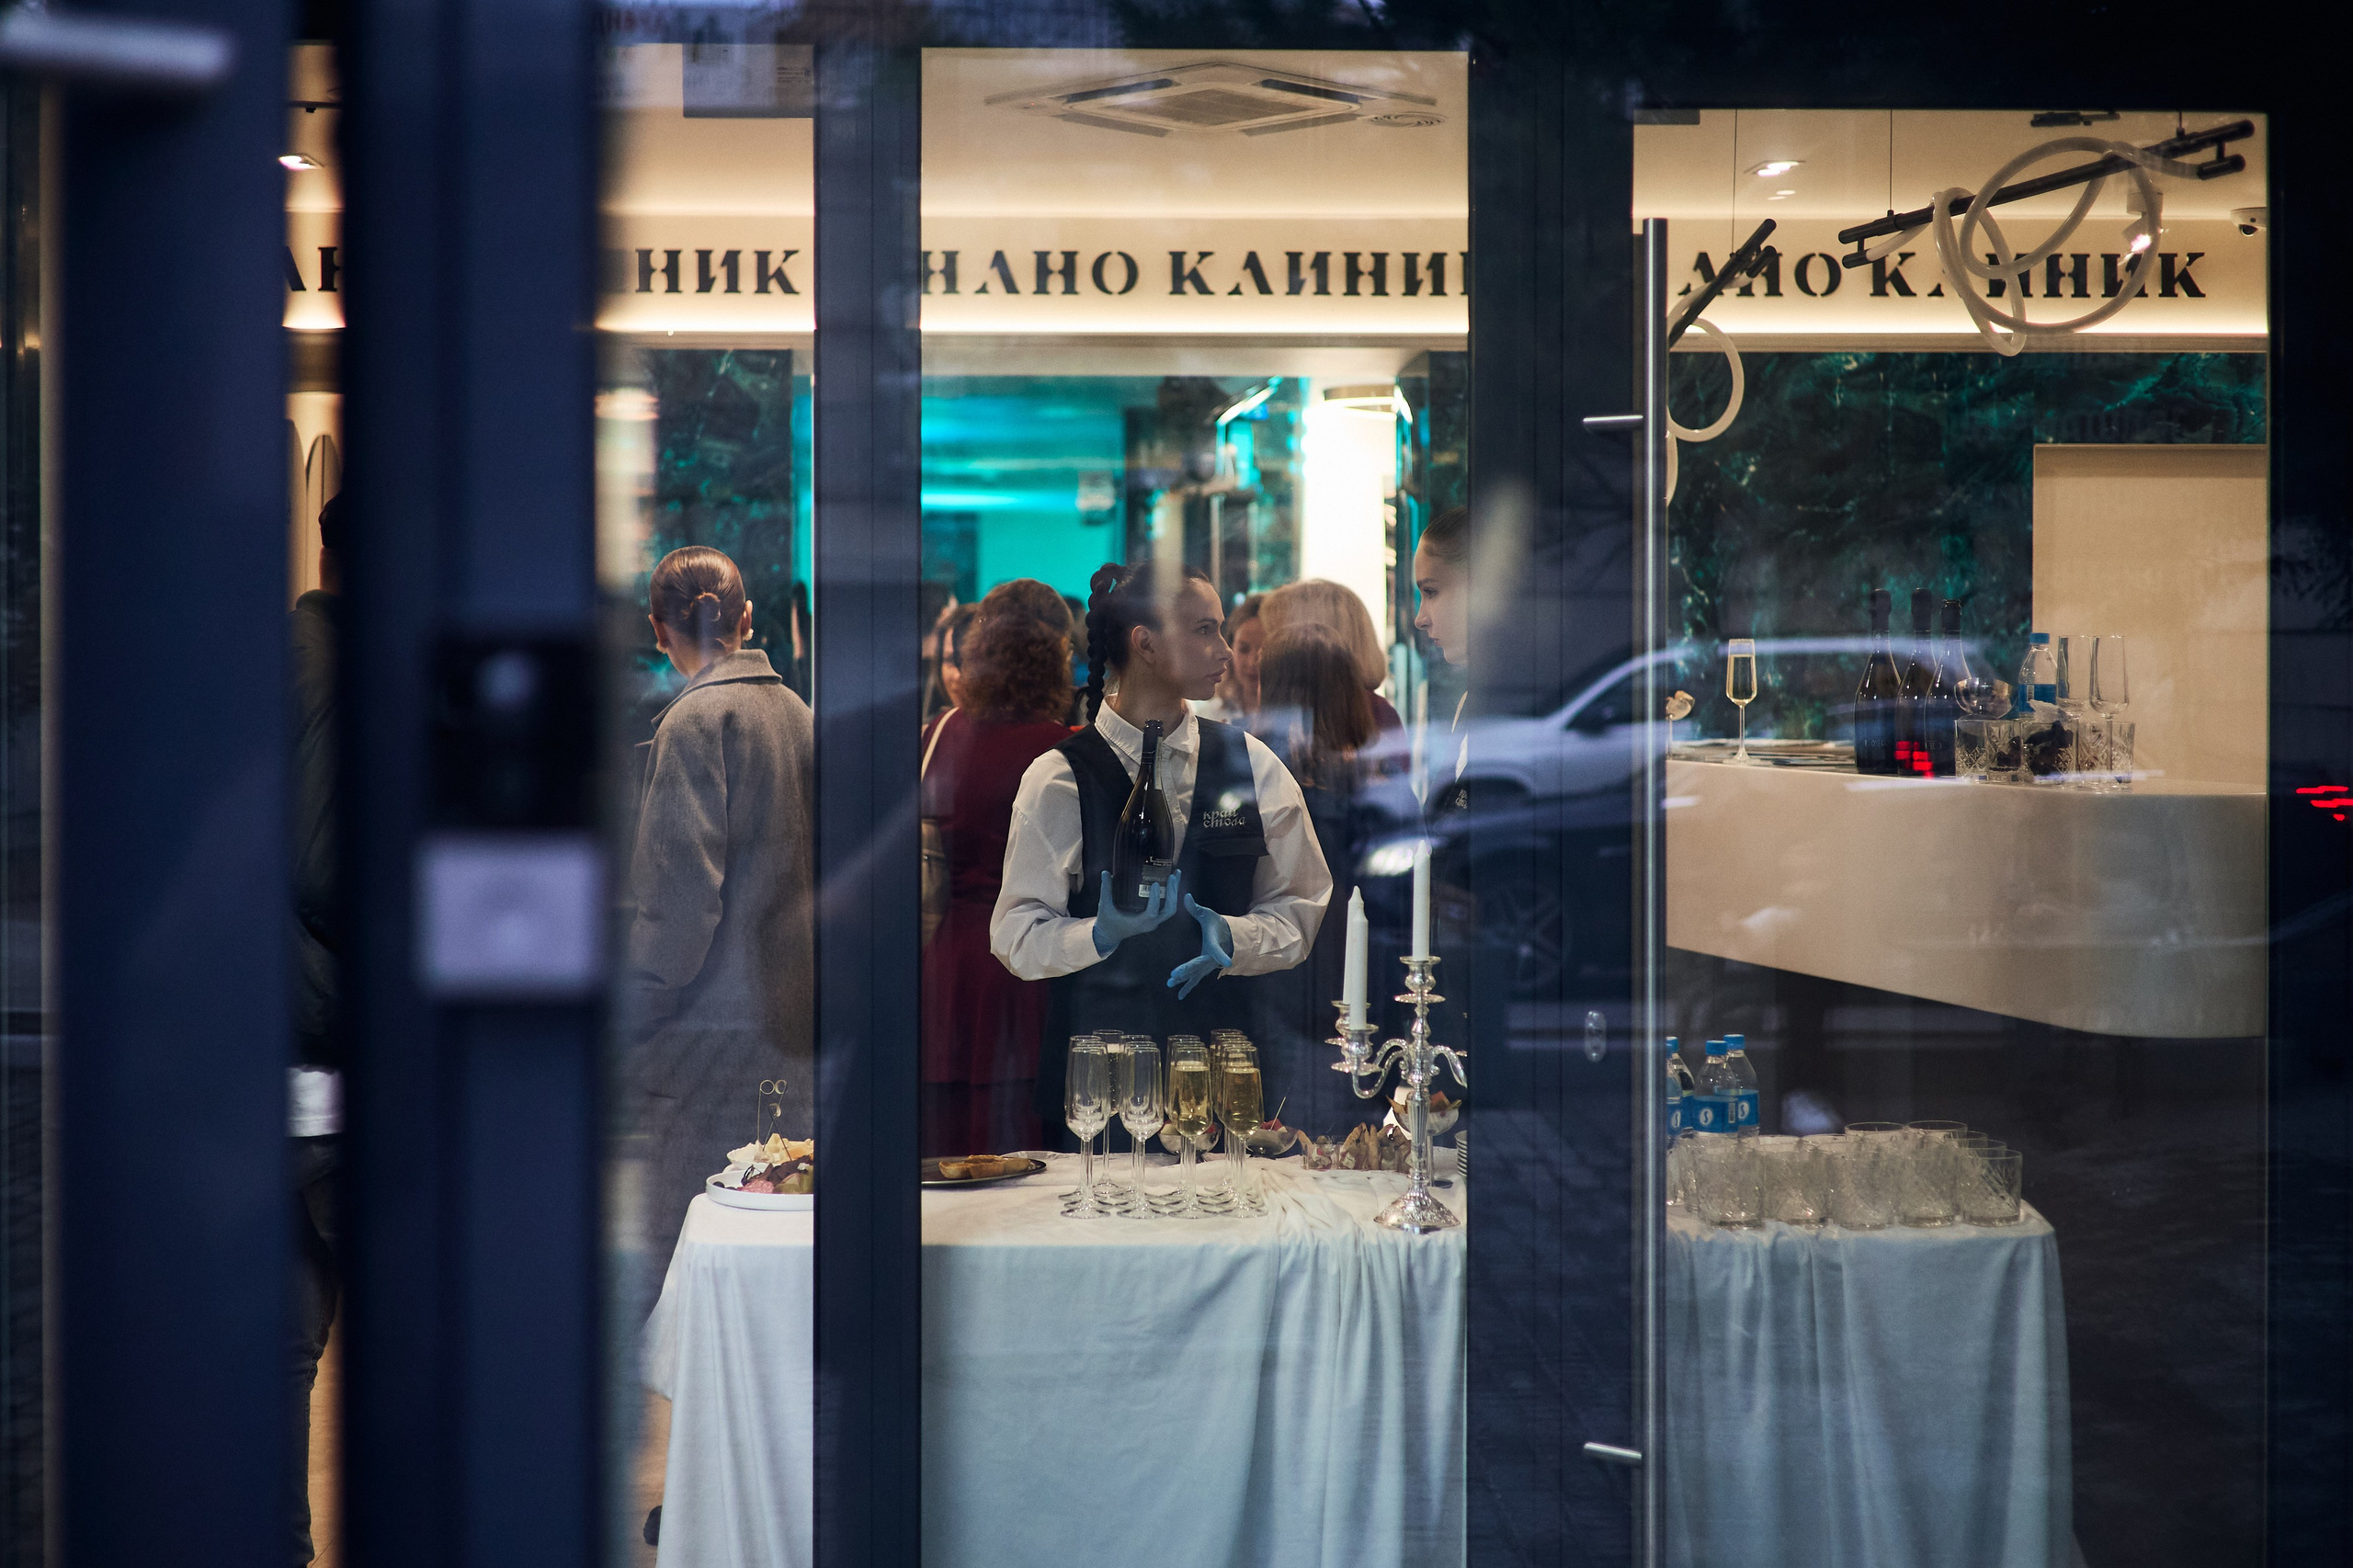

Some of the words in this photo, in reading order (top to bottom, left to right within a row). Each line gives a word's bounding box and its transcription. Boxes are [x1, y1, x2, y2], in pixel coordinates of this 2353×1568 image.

[921, 249, 1140, 295] НАНО
[1168, 250, 1469, 296] КЛИНИ
[1677, 251, 1842, 297] АНО
[1869, 251, 2207, 298] КИНИК
